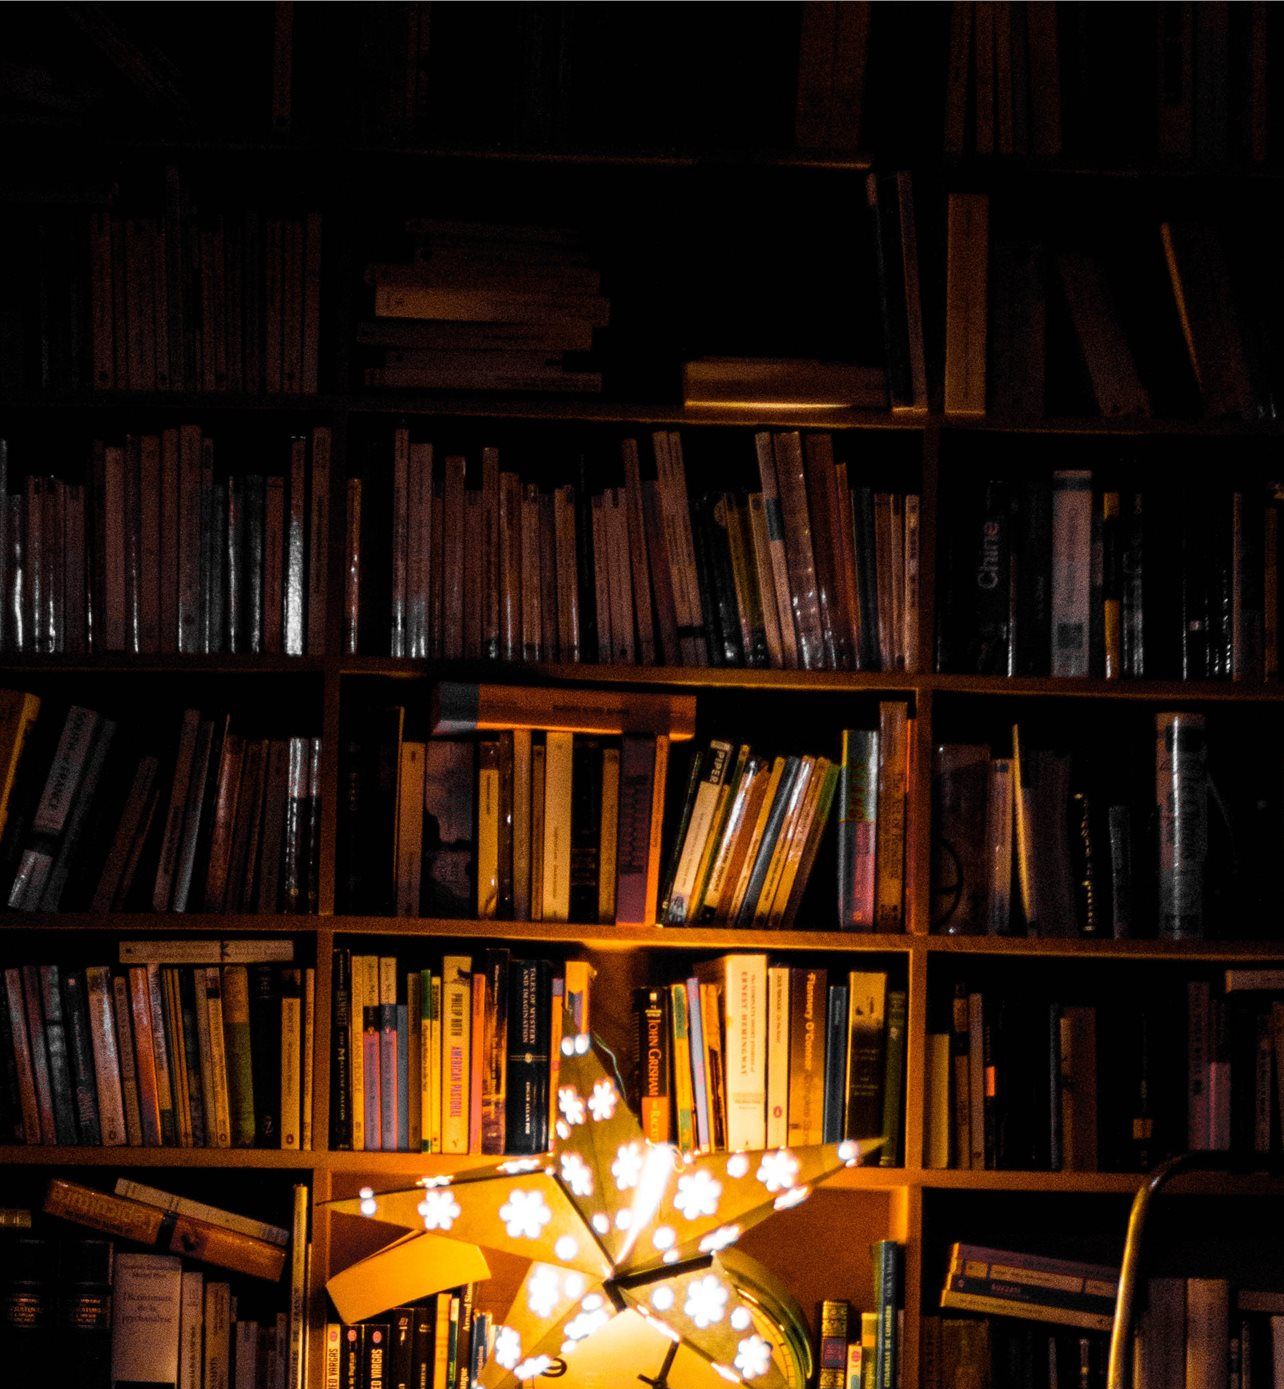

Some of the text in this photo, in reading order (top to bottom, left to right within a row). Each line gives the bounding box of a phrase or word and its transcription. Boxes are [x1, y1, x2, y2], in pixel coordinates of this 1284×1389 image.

[977, 521, 999, 589] Chine
[709, 750, 725, 782] PIPER
[848, 763, 865, 822] SLANG
[451, 993, 463, 1036] PHILIP ROTH
[529, 994, 536, 1005] OF
[804, 973, 816, 1019] Flannery
[740, 972, 748, 1075] ERNEST HEMINGWAY
[647, 1019, 661, 1096] JOHN GRISHAM
[804, 1021, 815, 1071] O'Connor
[450, 1046, 463, 1117] AMERICAN PASTORAL
[338, 1090, 346, 1121] FALCON
[462, 1281, 472, 1331] Arnaud Simo
[327, 1349, 337, 1376] VARGAS
[371, 1348, 382, 1379] VARGAS
[884, 1339, 892, 1349] DE
[884, 1351, 892, 1388] CITADELLE
